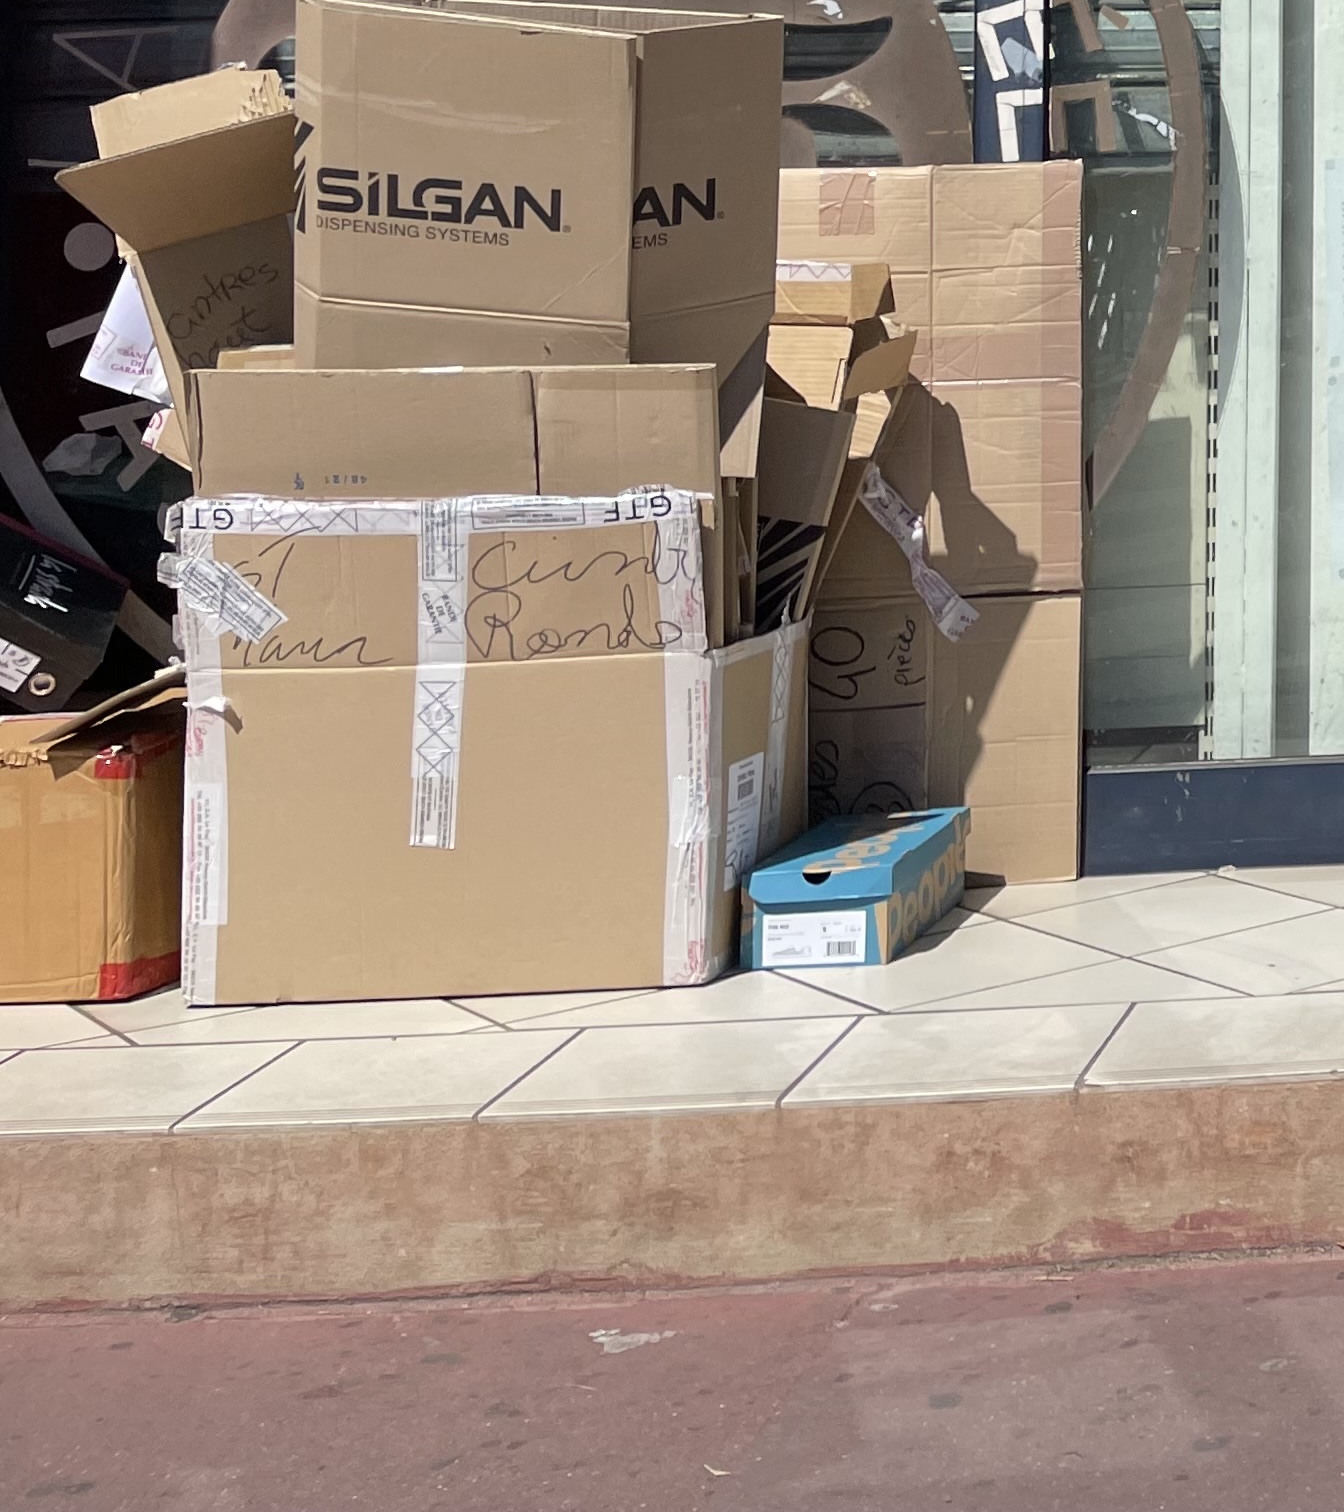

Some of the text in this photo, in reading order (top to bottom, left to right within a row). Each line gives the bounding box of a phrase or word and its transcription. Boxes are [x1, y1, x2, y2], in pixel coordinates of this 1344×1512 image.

[316, 166, 561, 234] SILGAN
[315, 214, 510, 247] DISPENSING SYSTEMS
[603, 494, 672, 523] GTF
